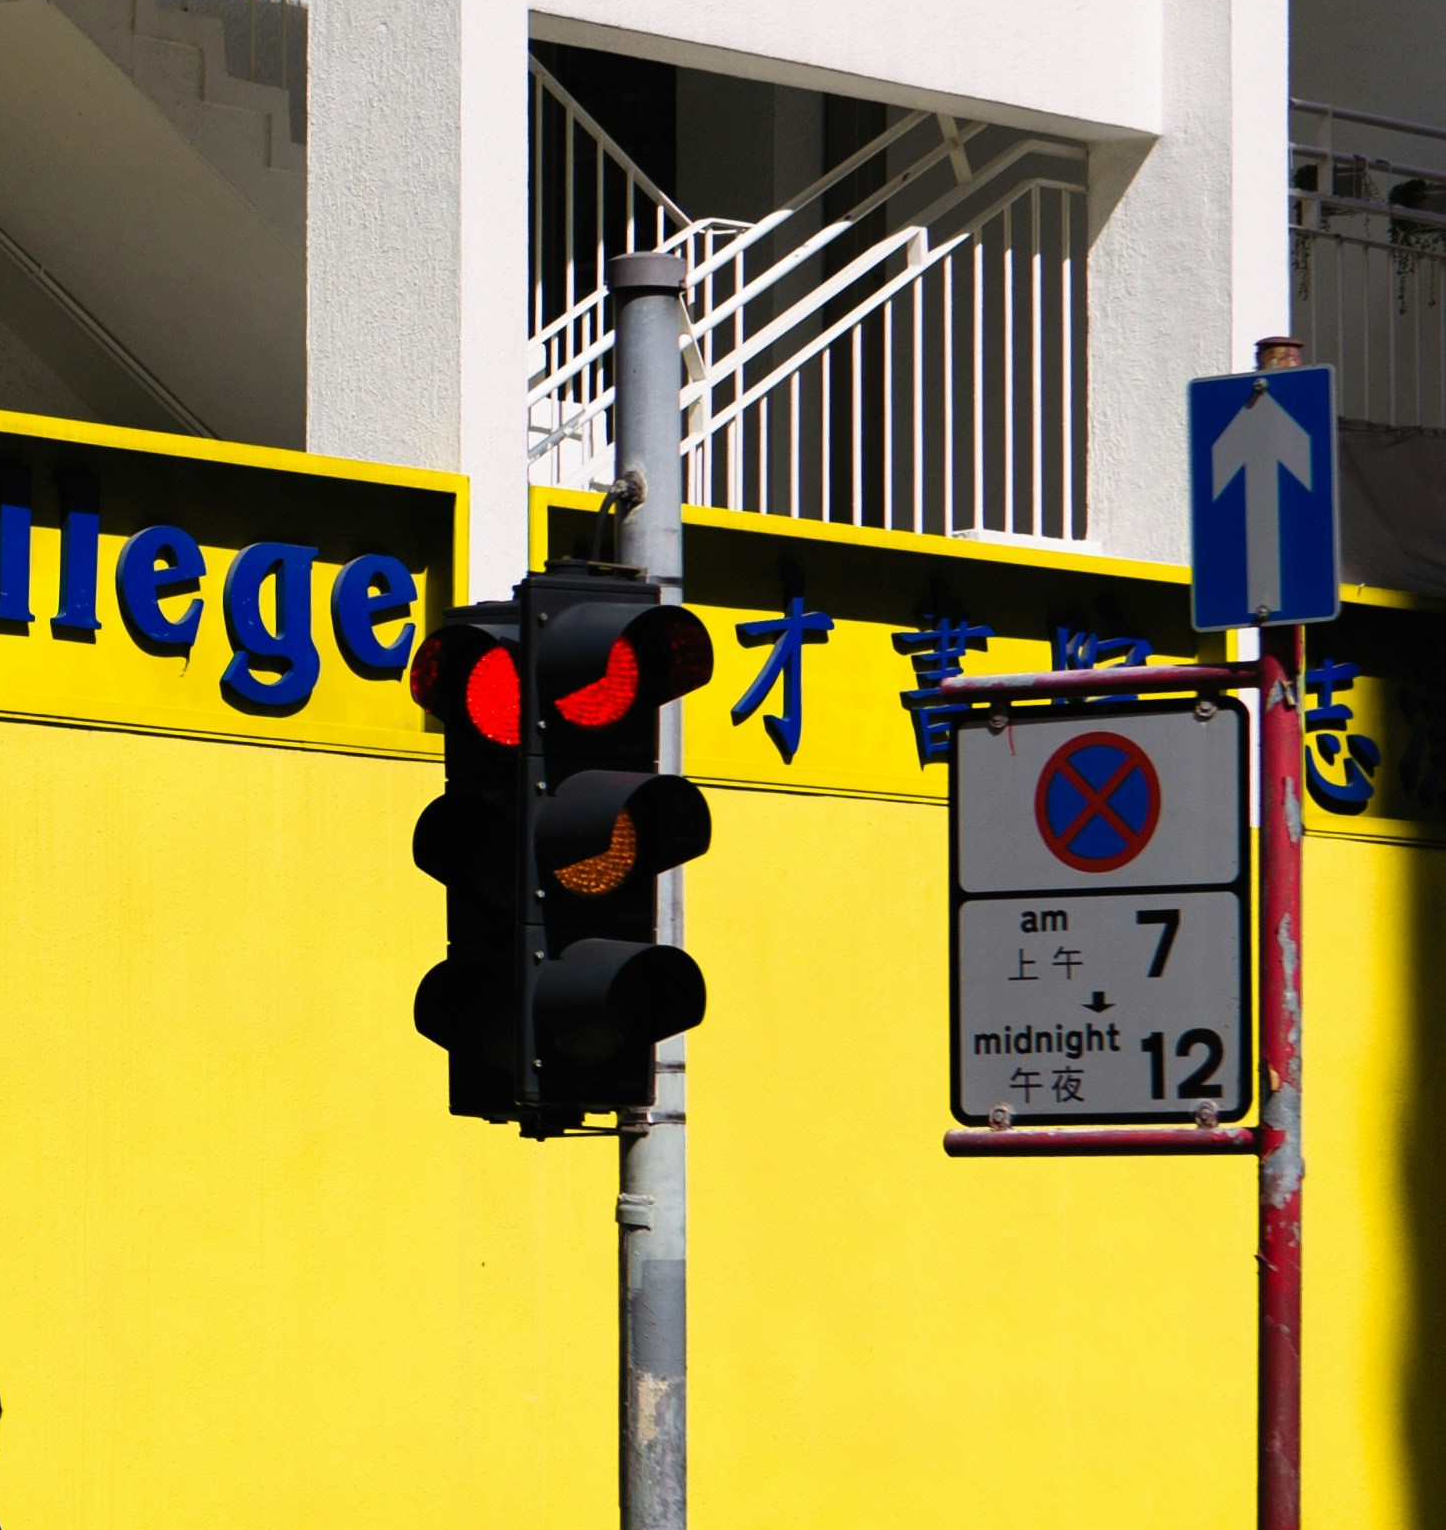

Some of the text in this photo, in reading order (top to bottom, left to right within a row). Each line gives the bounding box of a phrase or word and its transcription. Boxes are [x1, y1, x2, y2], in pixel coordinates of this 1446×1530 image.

[1020, 909, 1068, 933] am
[1136, 909, 1181, 978] 7
[1008, 946, 1084, 981] 上午
[974, 1023, 1121, 1059] midnight
[1141, 1028, 1224, 1100] 12
[1009, 1066, 1085, 1104] 午夜
